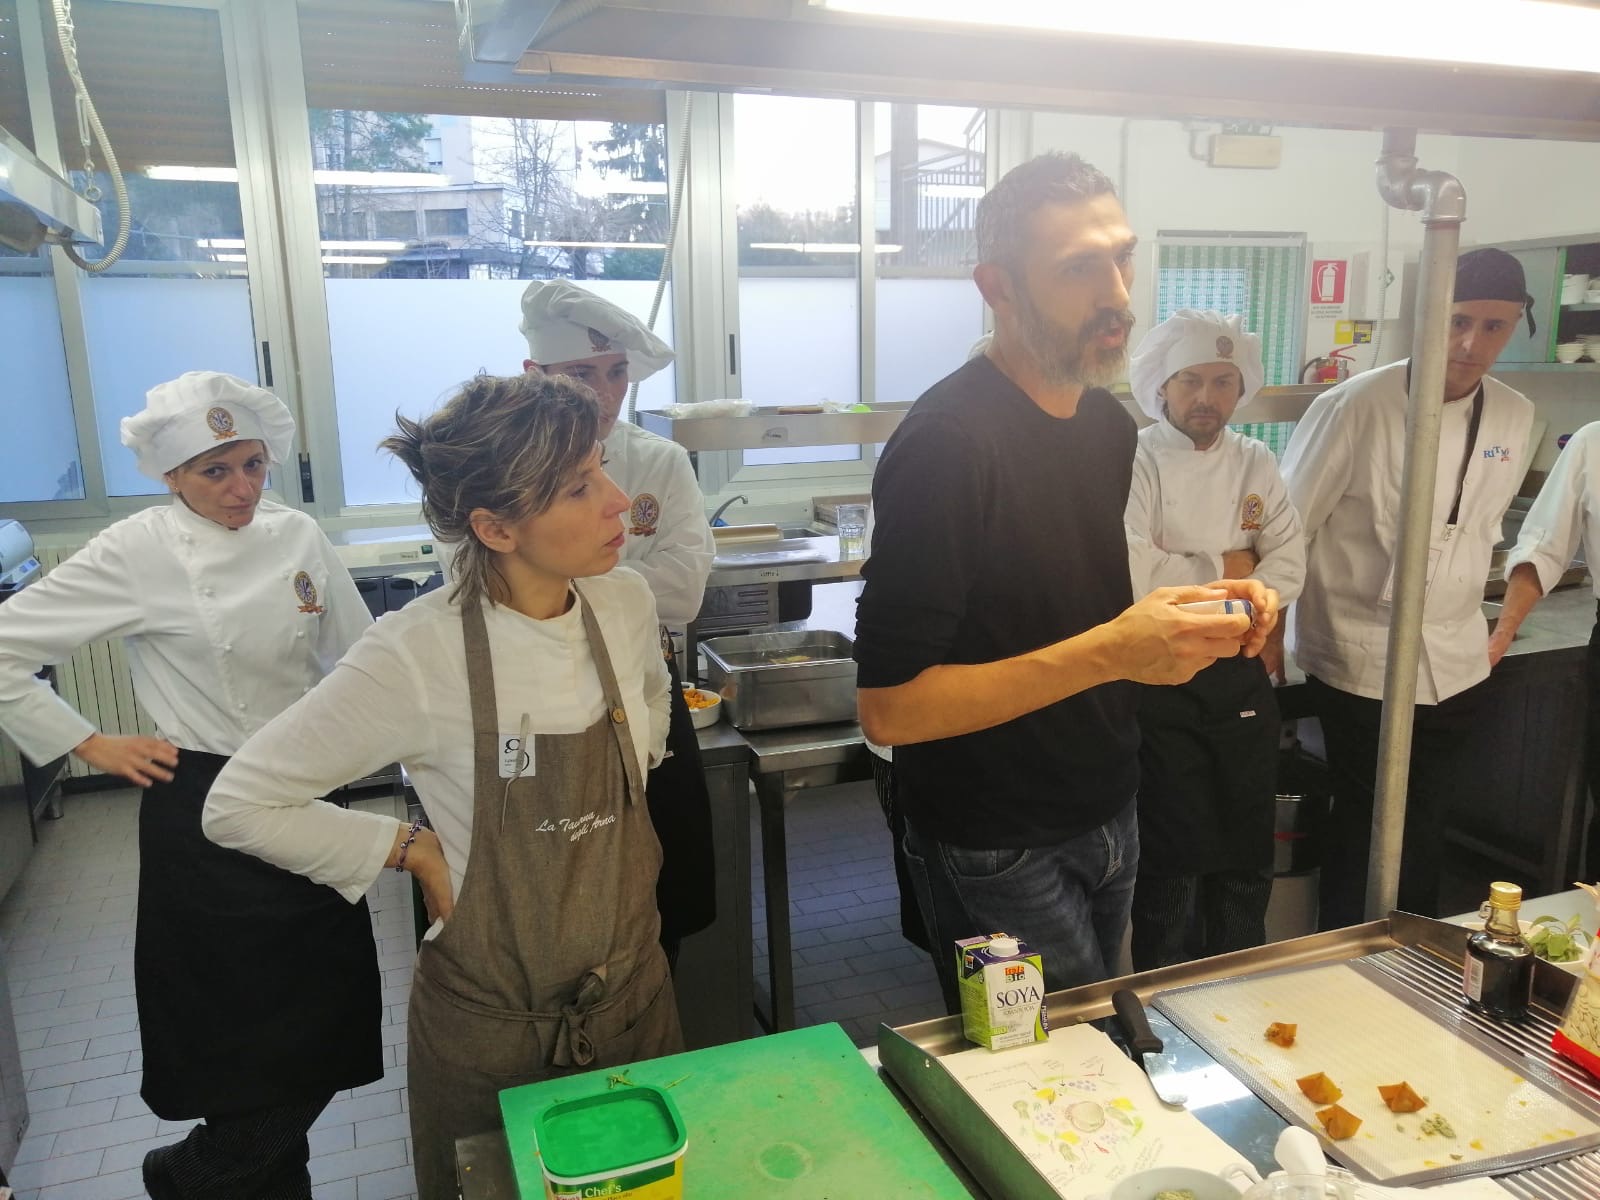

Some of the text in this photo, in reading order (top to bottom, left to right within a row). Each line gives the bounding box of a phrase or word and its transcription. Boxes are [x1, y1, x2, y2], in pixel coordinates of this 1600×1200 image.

[536, 819, 556, 832] La
[996, 986, 1041, 1008] SOYA
[585, 1184, 622, 1198] Chef's
